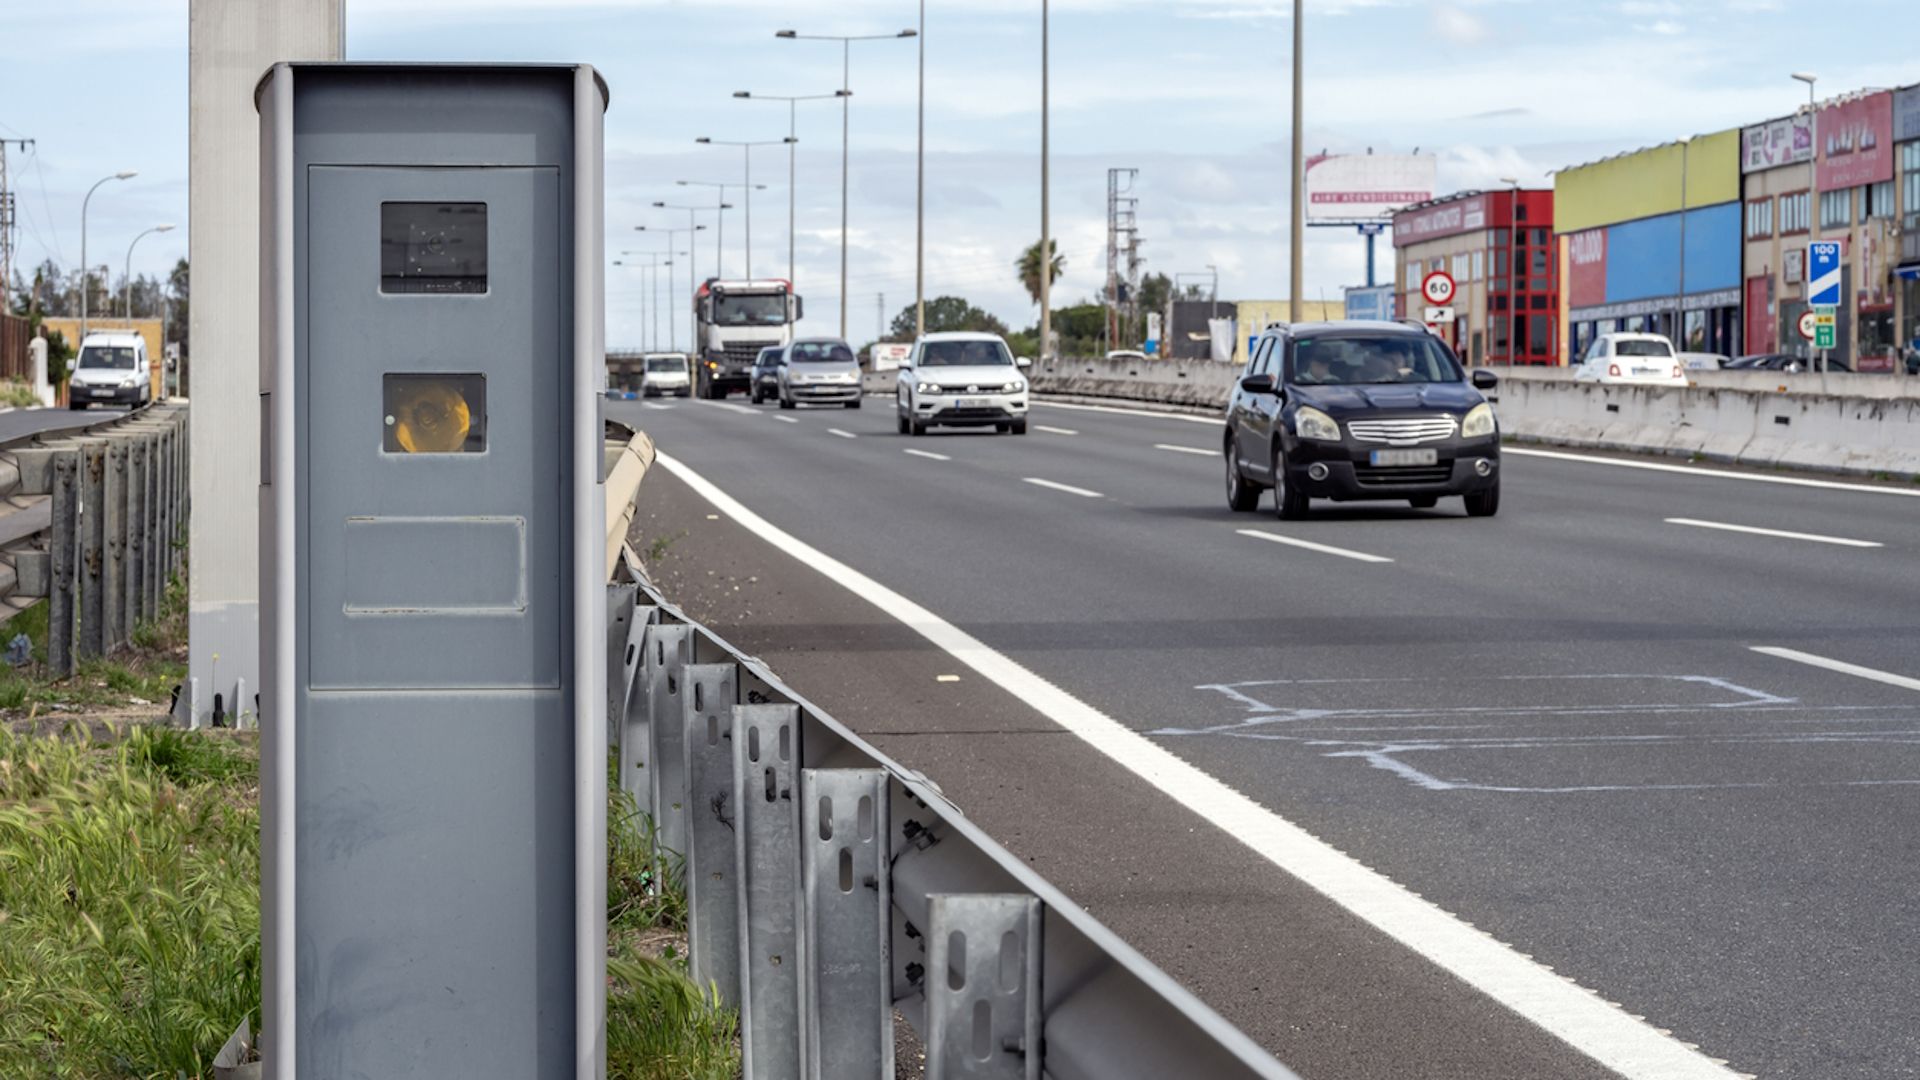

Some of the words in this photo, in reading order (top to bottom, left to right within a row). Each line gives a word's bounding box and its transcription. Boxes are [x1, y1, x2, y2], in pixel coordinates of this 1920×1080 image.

[1814, 245, 1835, 255] 100
[1430, 282, 1449, 293] 60
[1820, 335, 1830, 344] 11
